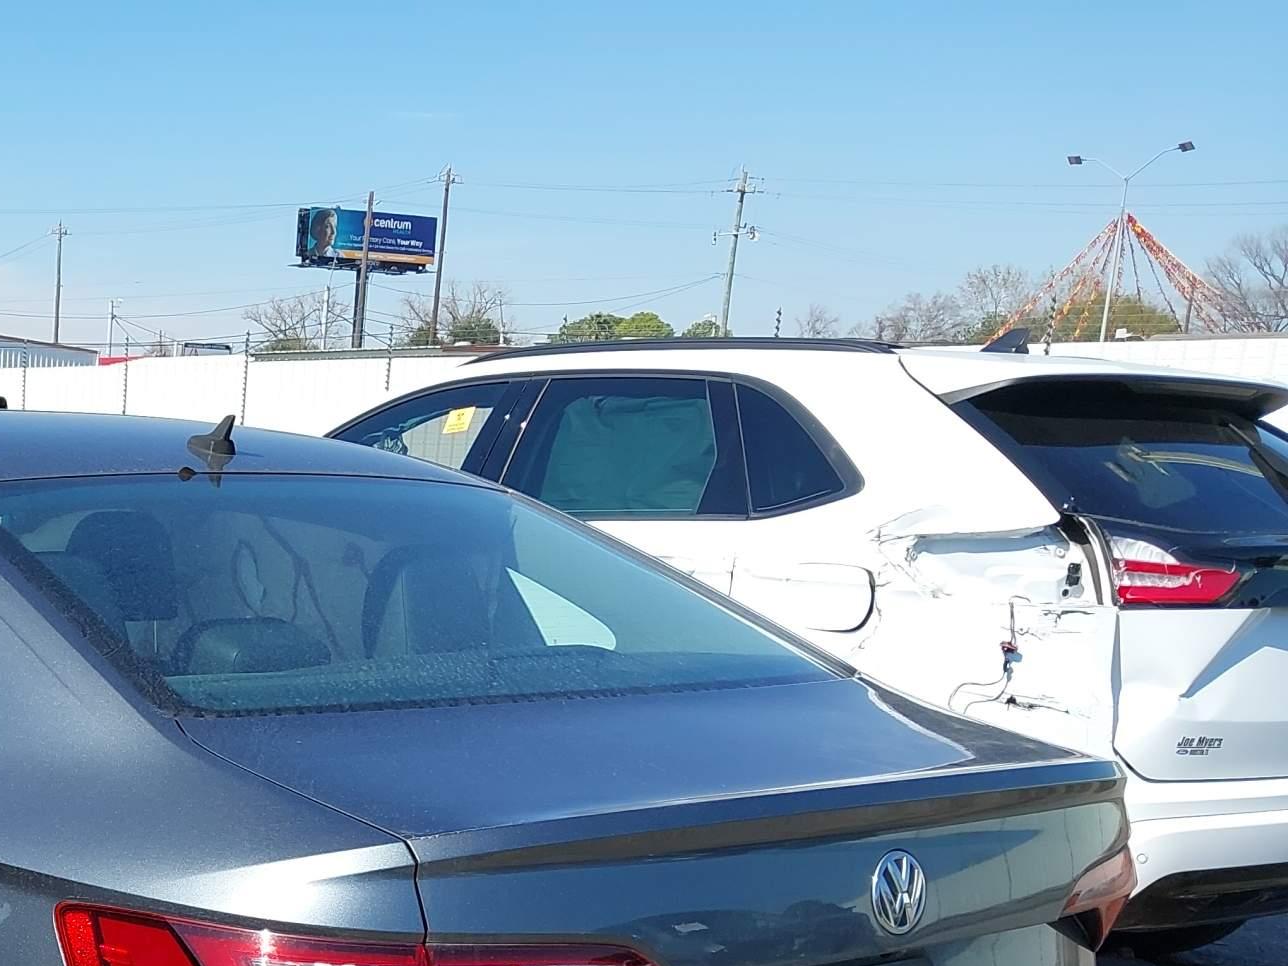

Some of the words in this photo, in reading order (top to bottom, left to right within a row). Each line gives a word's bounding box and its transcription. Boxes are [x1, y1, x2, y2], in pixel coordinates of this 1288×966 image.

[374, 218, 412, 230] centrum
[1177, 736, 1196, 747] Joe
[1196, 736, 1223, 748] Myers
